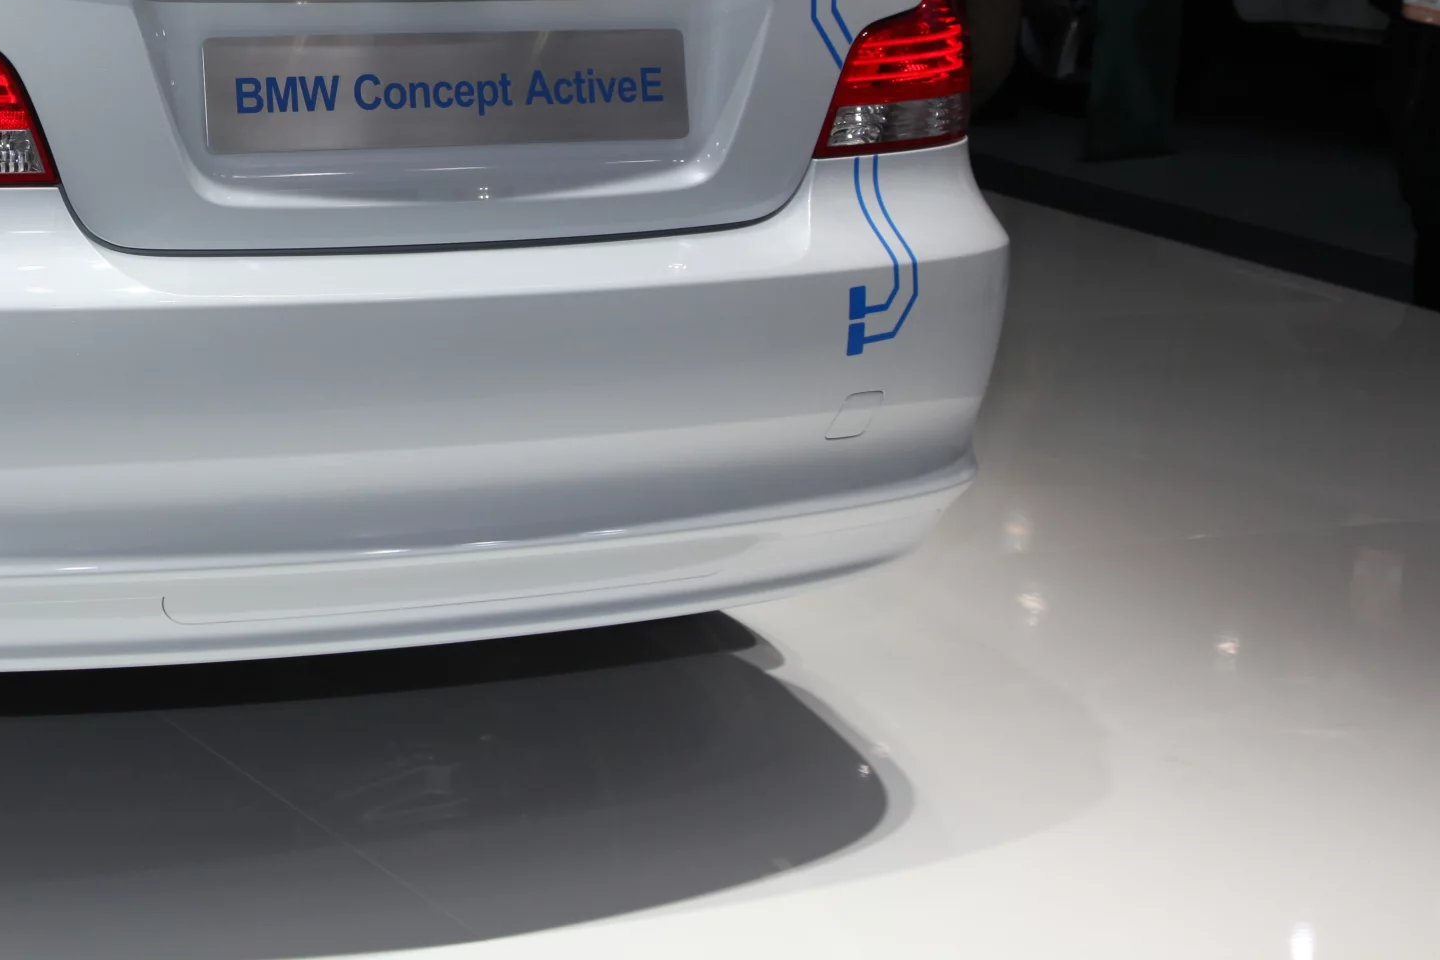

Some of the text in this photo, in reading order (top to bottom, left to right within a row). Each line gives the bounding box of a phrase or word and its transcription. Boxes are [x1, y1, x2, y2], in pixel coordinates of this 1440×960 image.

[235, 67, 665, 116] BMW Concept ActiveE
